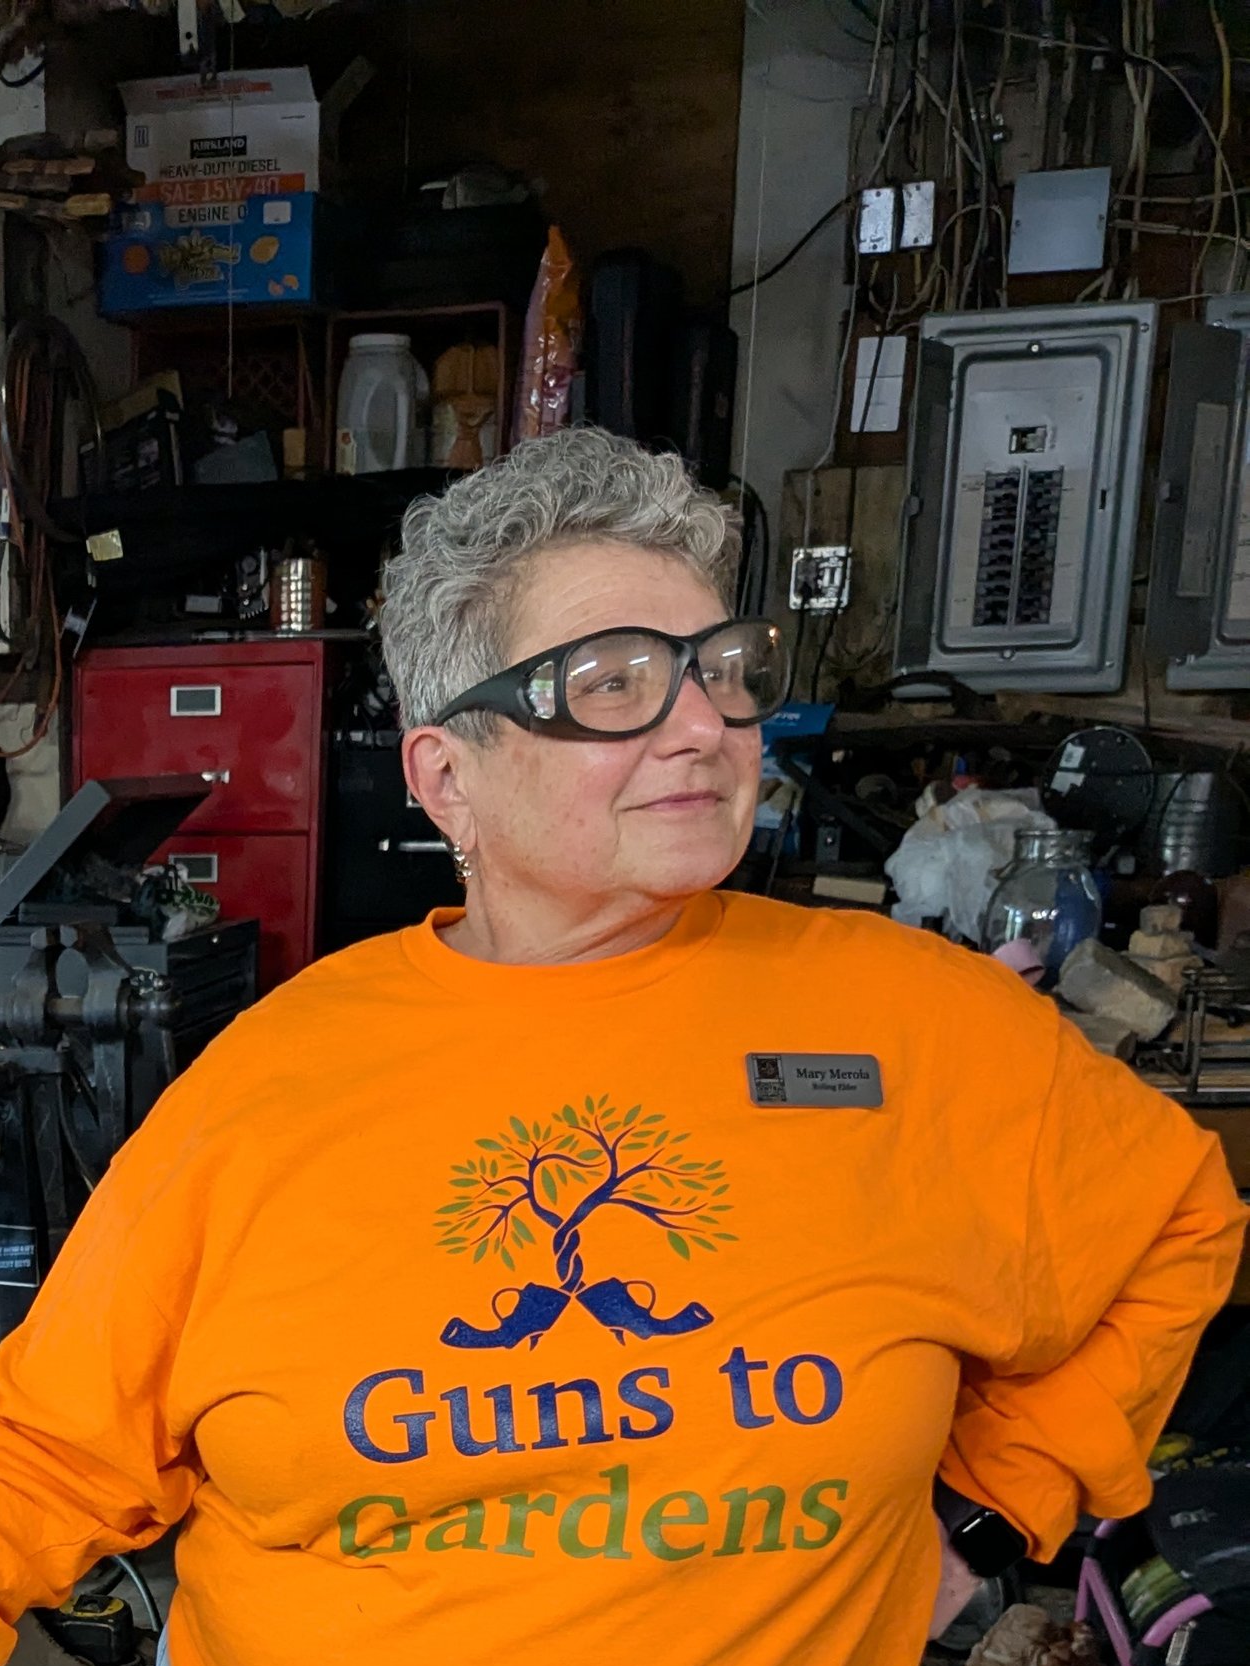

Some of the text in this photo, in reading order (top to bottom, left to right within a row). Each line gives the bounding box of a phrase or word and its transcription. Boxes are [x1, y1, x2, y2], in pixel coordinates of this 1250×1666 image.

[193, 138, 246, 151] KIRKLAND
[237, 159, 281, 174] DIESEL
[159, 182, 193, 204] SAE
[178, 206, 230, 224] ENGINE
[796, 1068, 826, 1082] Mary
[343, 1346, 844, 1464] Guns to
[338, 1464, 849, 1561] Gardens
